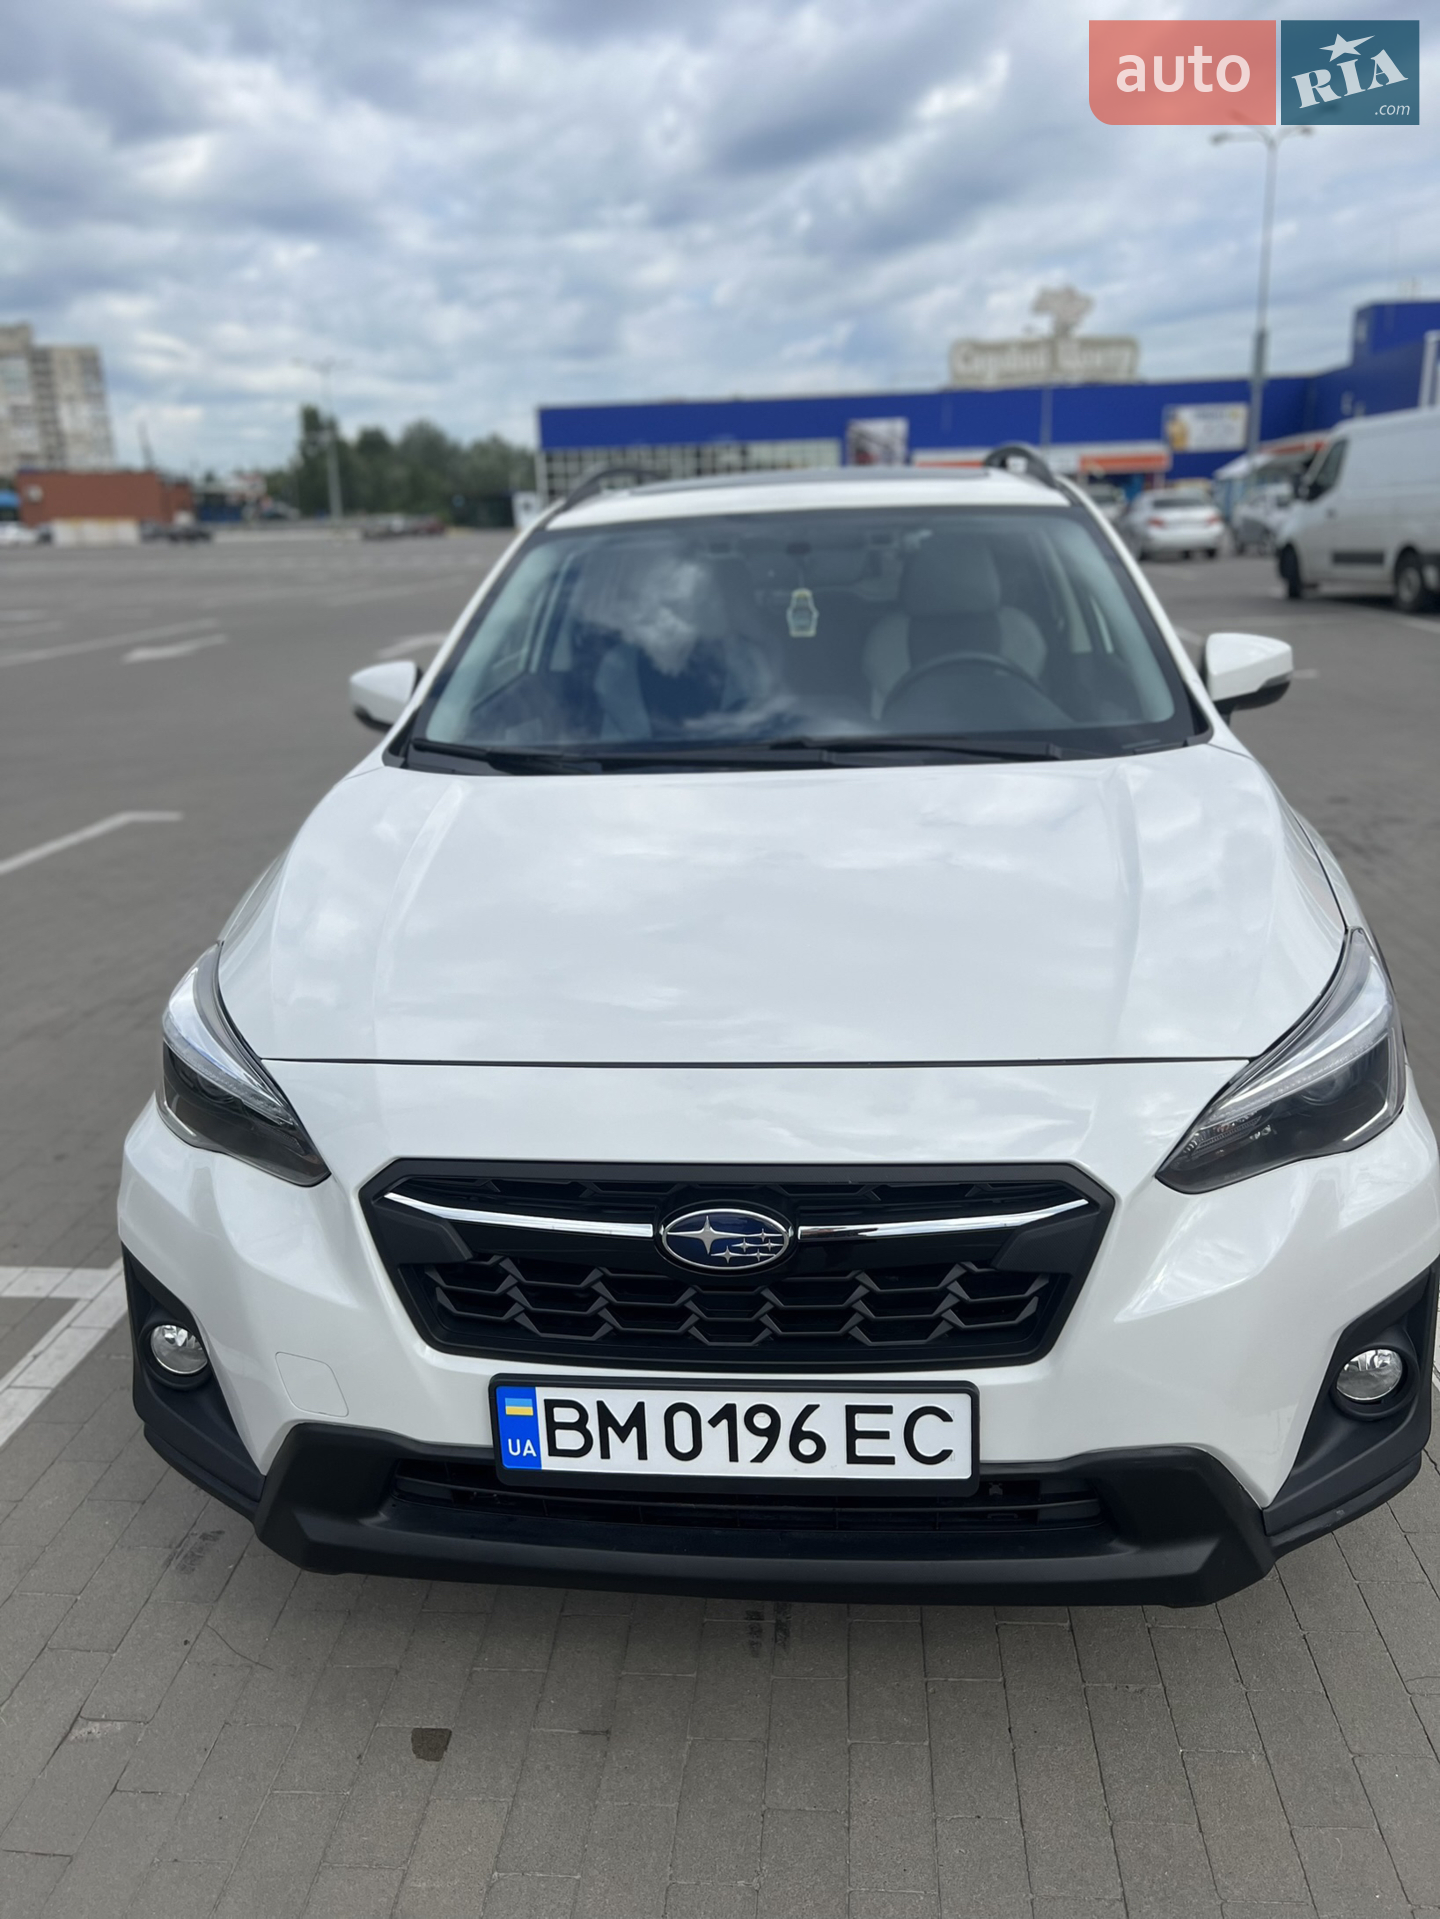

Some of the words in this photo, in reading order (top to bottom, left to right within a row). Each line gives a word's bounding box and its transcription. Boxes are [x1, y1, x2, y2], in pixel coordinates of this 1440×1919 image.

[507, 1438, 537, 1458] UA
[543, 1398, 648, 1460] BM
[663, 1401, 827, 1463] 0196
[845, 1404, 954, 1466] EC
